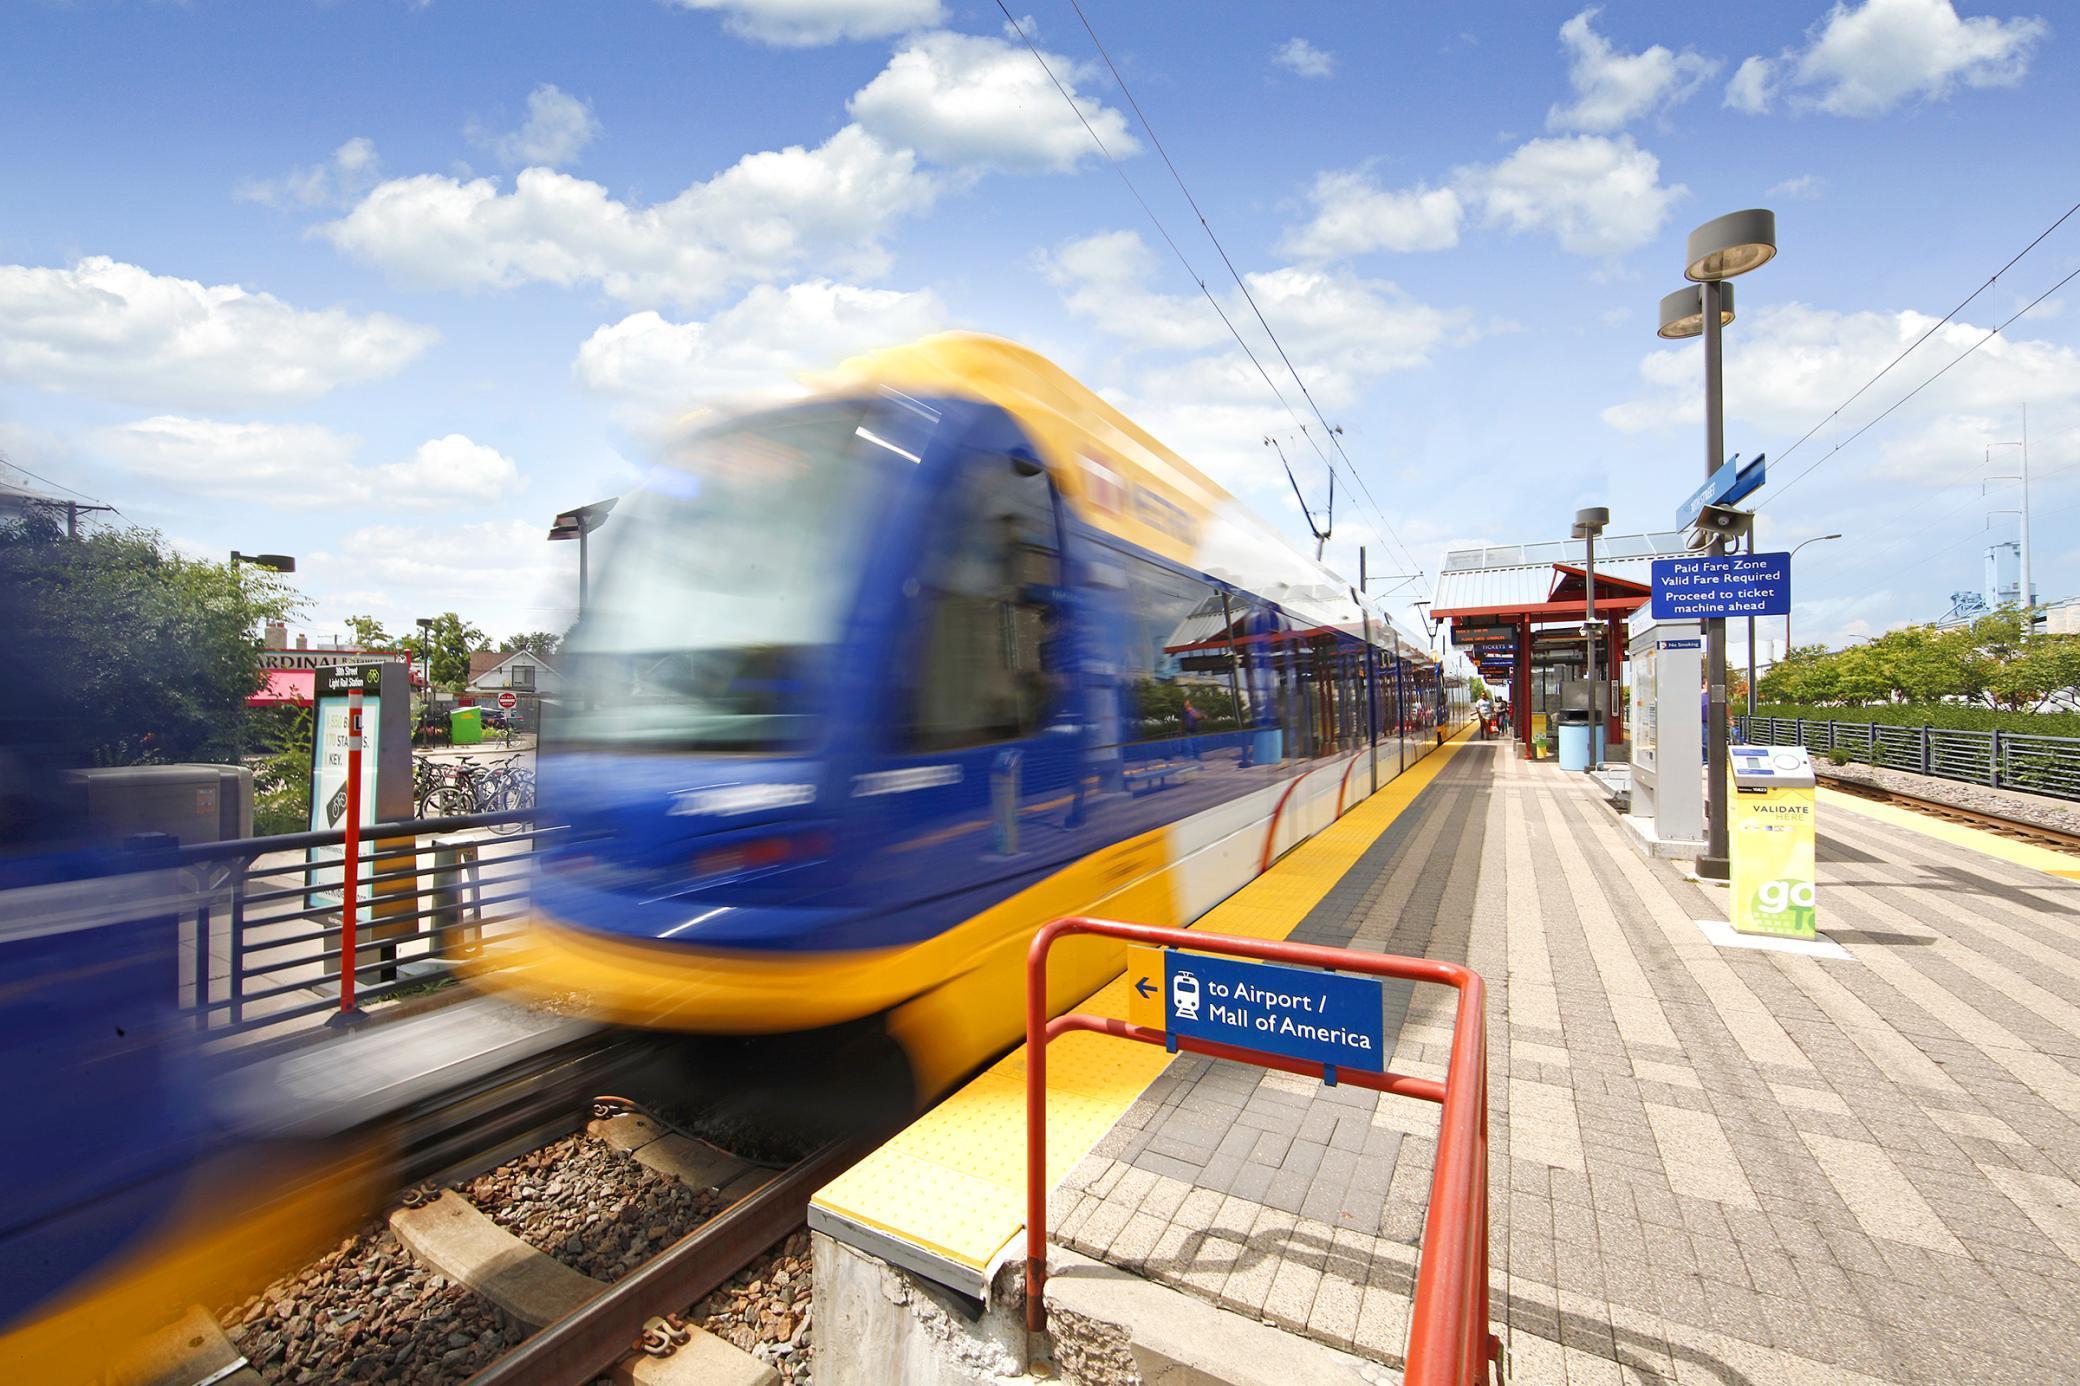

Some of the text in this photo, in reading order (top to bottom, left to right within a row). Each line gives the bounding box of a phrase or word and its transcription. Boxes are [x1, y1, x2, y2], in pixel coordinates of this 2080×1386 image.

[1674, 560, 1767, 573] Paid Fare Zone
[1661, 571, 1780, 586] Valid Fare Required
[1666, 588, 1775, 601] Proceed to ticket
[1674, 601, 1766, 613] machine ahead
[329, 676, 364, 690] Light Rail Station
[1753, 805, 1809, 814] VALIDATE
[1775, 813, 1805, 821] HERE
[1757, 880, 1815, 914] go
[1208, 981, 1327, 1014] to Airport /
[1209, 1003, 1372, 1050] Mall of America
